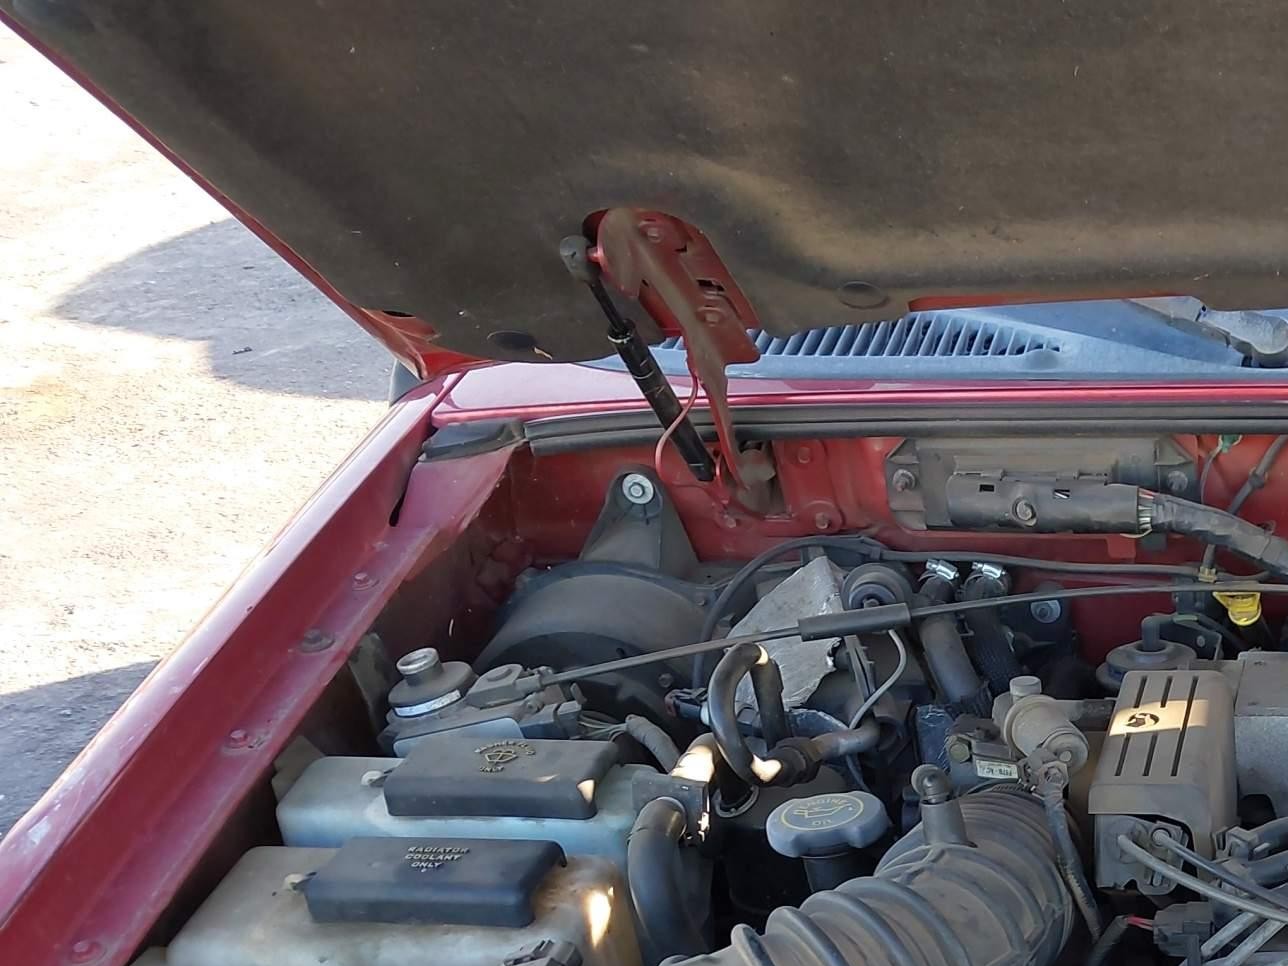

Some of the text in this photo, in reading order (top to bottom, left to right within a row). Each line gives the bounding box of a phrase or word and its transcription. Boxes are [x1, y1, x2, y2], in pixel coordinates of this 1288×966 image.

[407, 846, 470, 855] RADIATOR
[404, 853, 463, 861] COOLANT
[410, 861, 443, 869] ONLY
